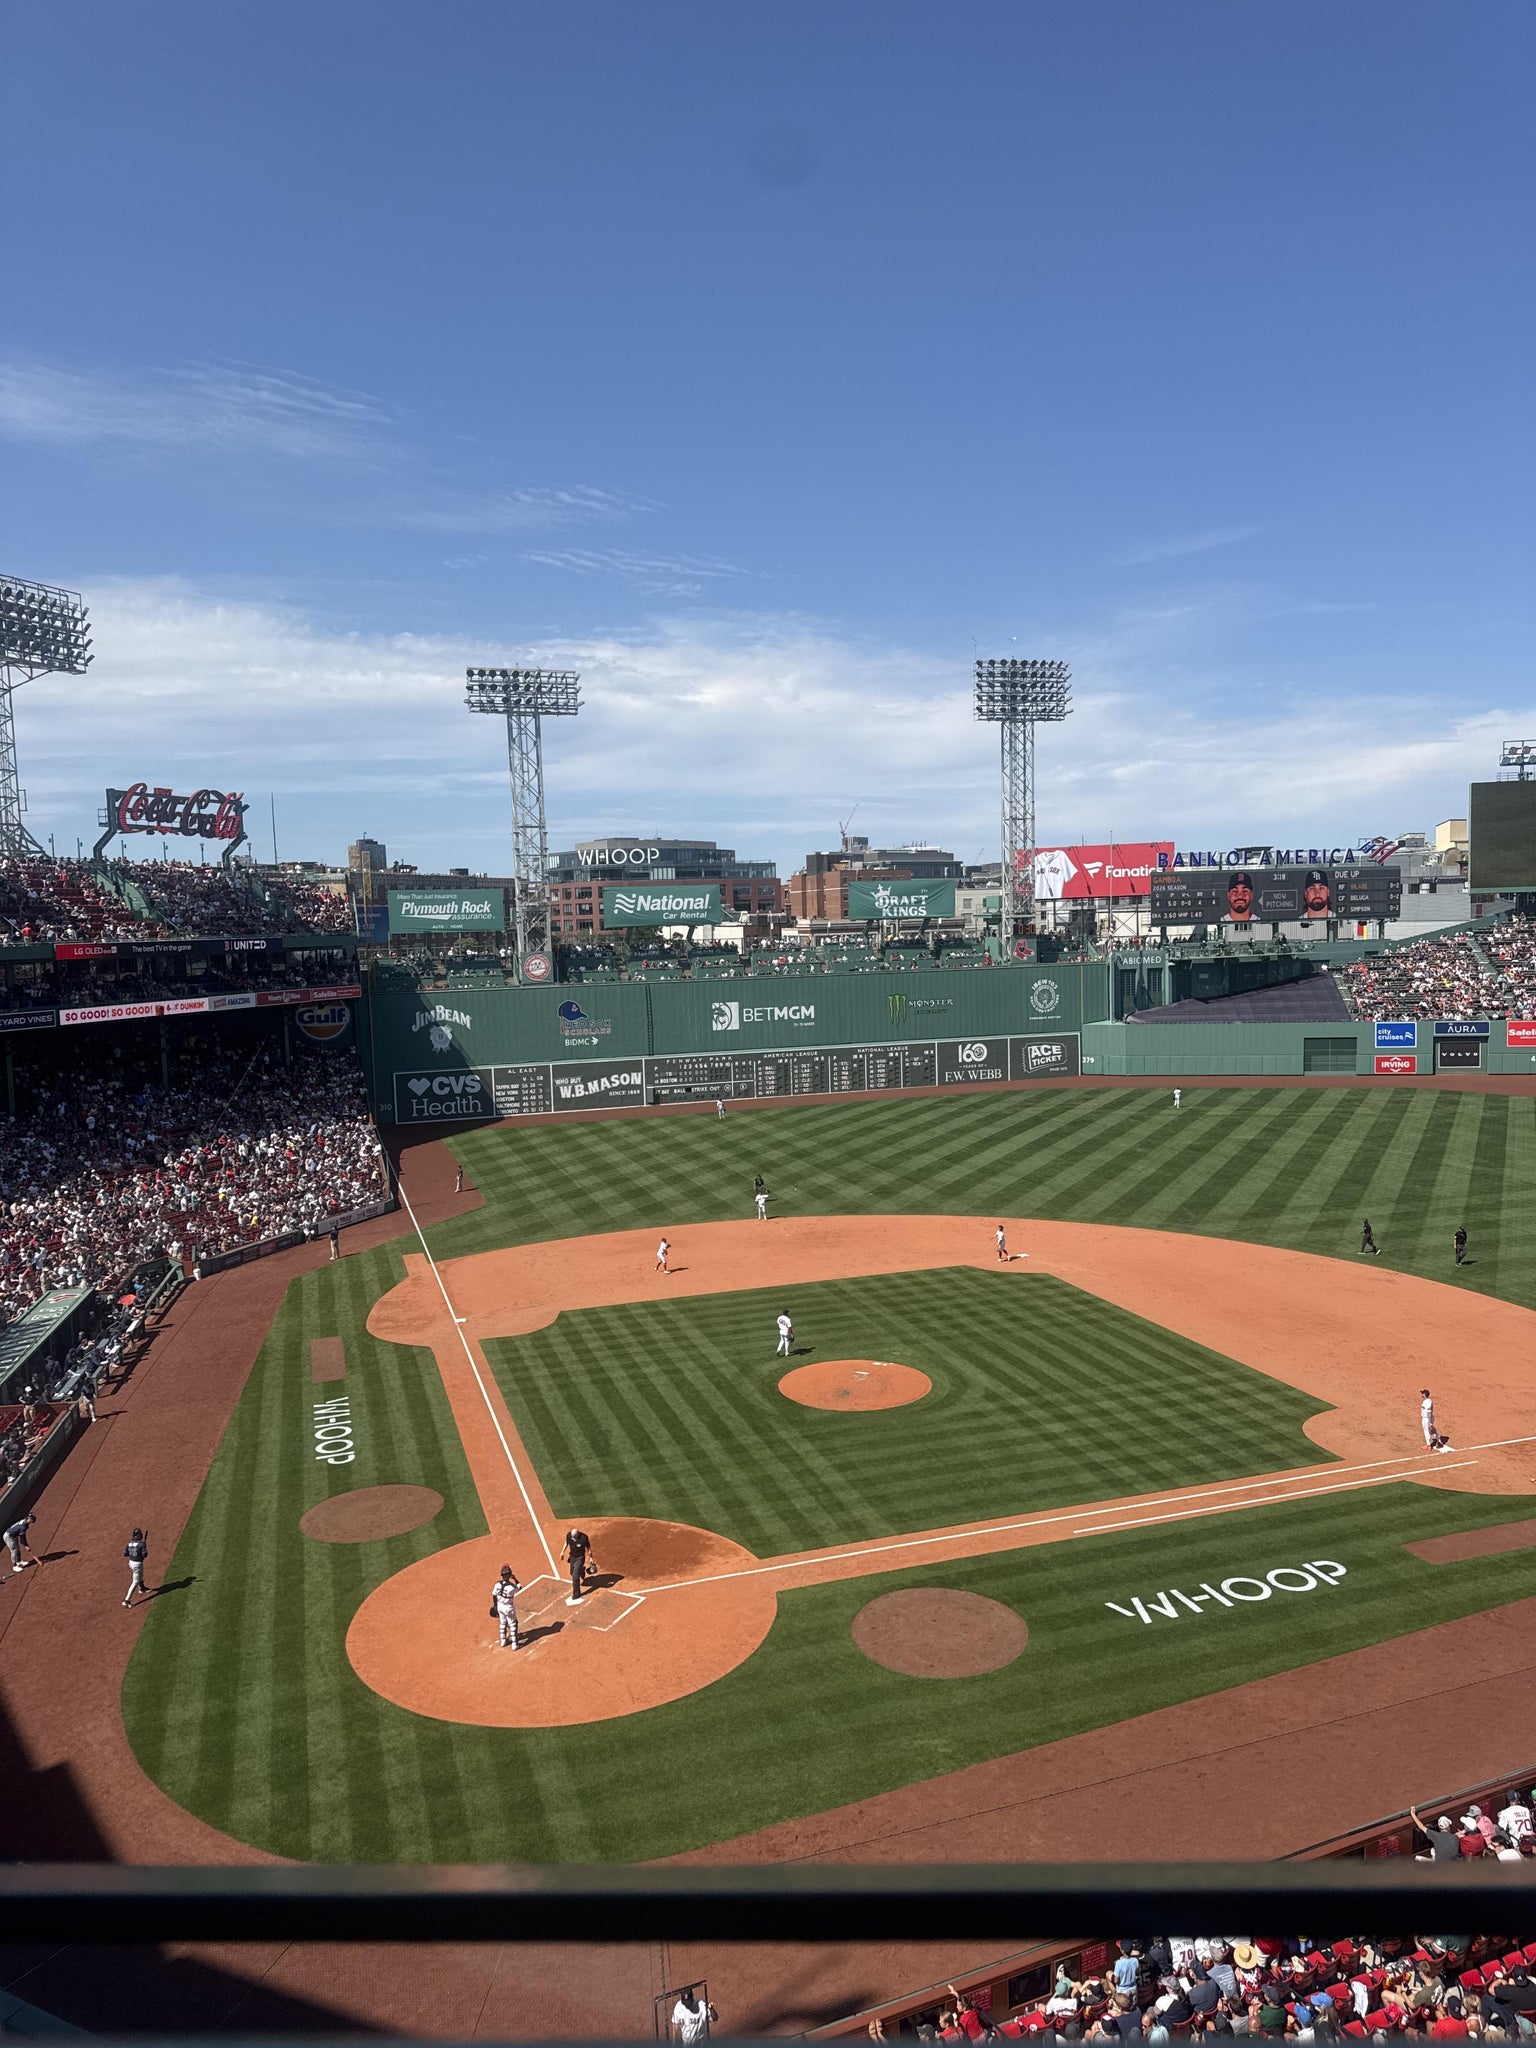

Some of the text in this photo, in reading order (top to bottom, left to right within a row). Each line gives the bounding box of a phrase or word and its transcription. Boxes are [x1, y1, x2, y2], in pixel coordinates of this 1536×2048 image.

[118, 783, 242, 839] Coca-Cola
[577, 848, 659, 866] WHOOP
[1158, 847, 1356, 868] BANK OF AMERICA
[402, 900, 492, 916] Plymouth Rock
[636, 894, 711, 912] National
[874, 895, 928, 908] DRAFT
[663, 911, 708, 920] Car Rental
[882, 906, 927, 917] KINGS
[74, 948, 83, 956] LG
[85, 947, 103, 955] OLED
[143, 945, 155, 953] best
[155, 944, 163, 952] TV
[178, 945, 192, 953] game
[1122, 956, 1162, 965] ABIOMED
[1032, 979, 1058, 990] IBEW 103
[314, 990, 338, 999] Safelite
[0, 1014, 53, 1026] YARD VINES
[65, 1012, 78, 1022] SO
[80, 1010, 110, 1020] GOOD!
[111, 1008, 124, 1018] SO
[126, 1006, 154, 1016] GOOD!
[297, 1008, 347, 1025] Gulf
[411, 1004, 472, 1032] JIM BEAM
[742, 1005, 815, 1022] BETMGM
[564, 1019, 611, 1029] RED SOX
[564, 1038, 590, 1046] BIDMC
[958, 1043, 988, 1063] 160
[1030, 1044, 1062, 1058] ACE
[1032, 1054, 1062, 1066] TICKET
[1381, 1060, 1410, 1068] IRVING
[944, 1068, 1002, 1082] F.W. WEBB
[432, 1074, 482, 1096] CVS
[379, 1104, 392, 1112] 310
[410, 1096, 482, 1117] Health
[313, 1396, 355, 1464] WHOOP
[1105, 1560, 1348, 1624] WHOOP
[1514, 1819, 1532, 1832] 70
[1180, 1948, 1193, 1962] 70
